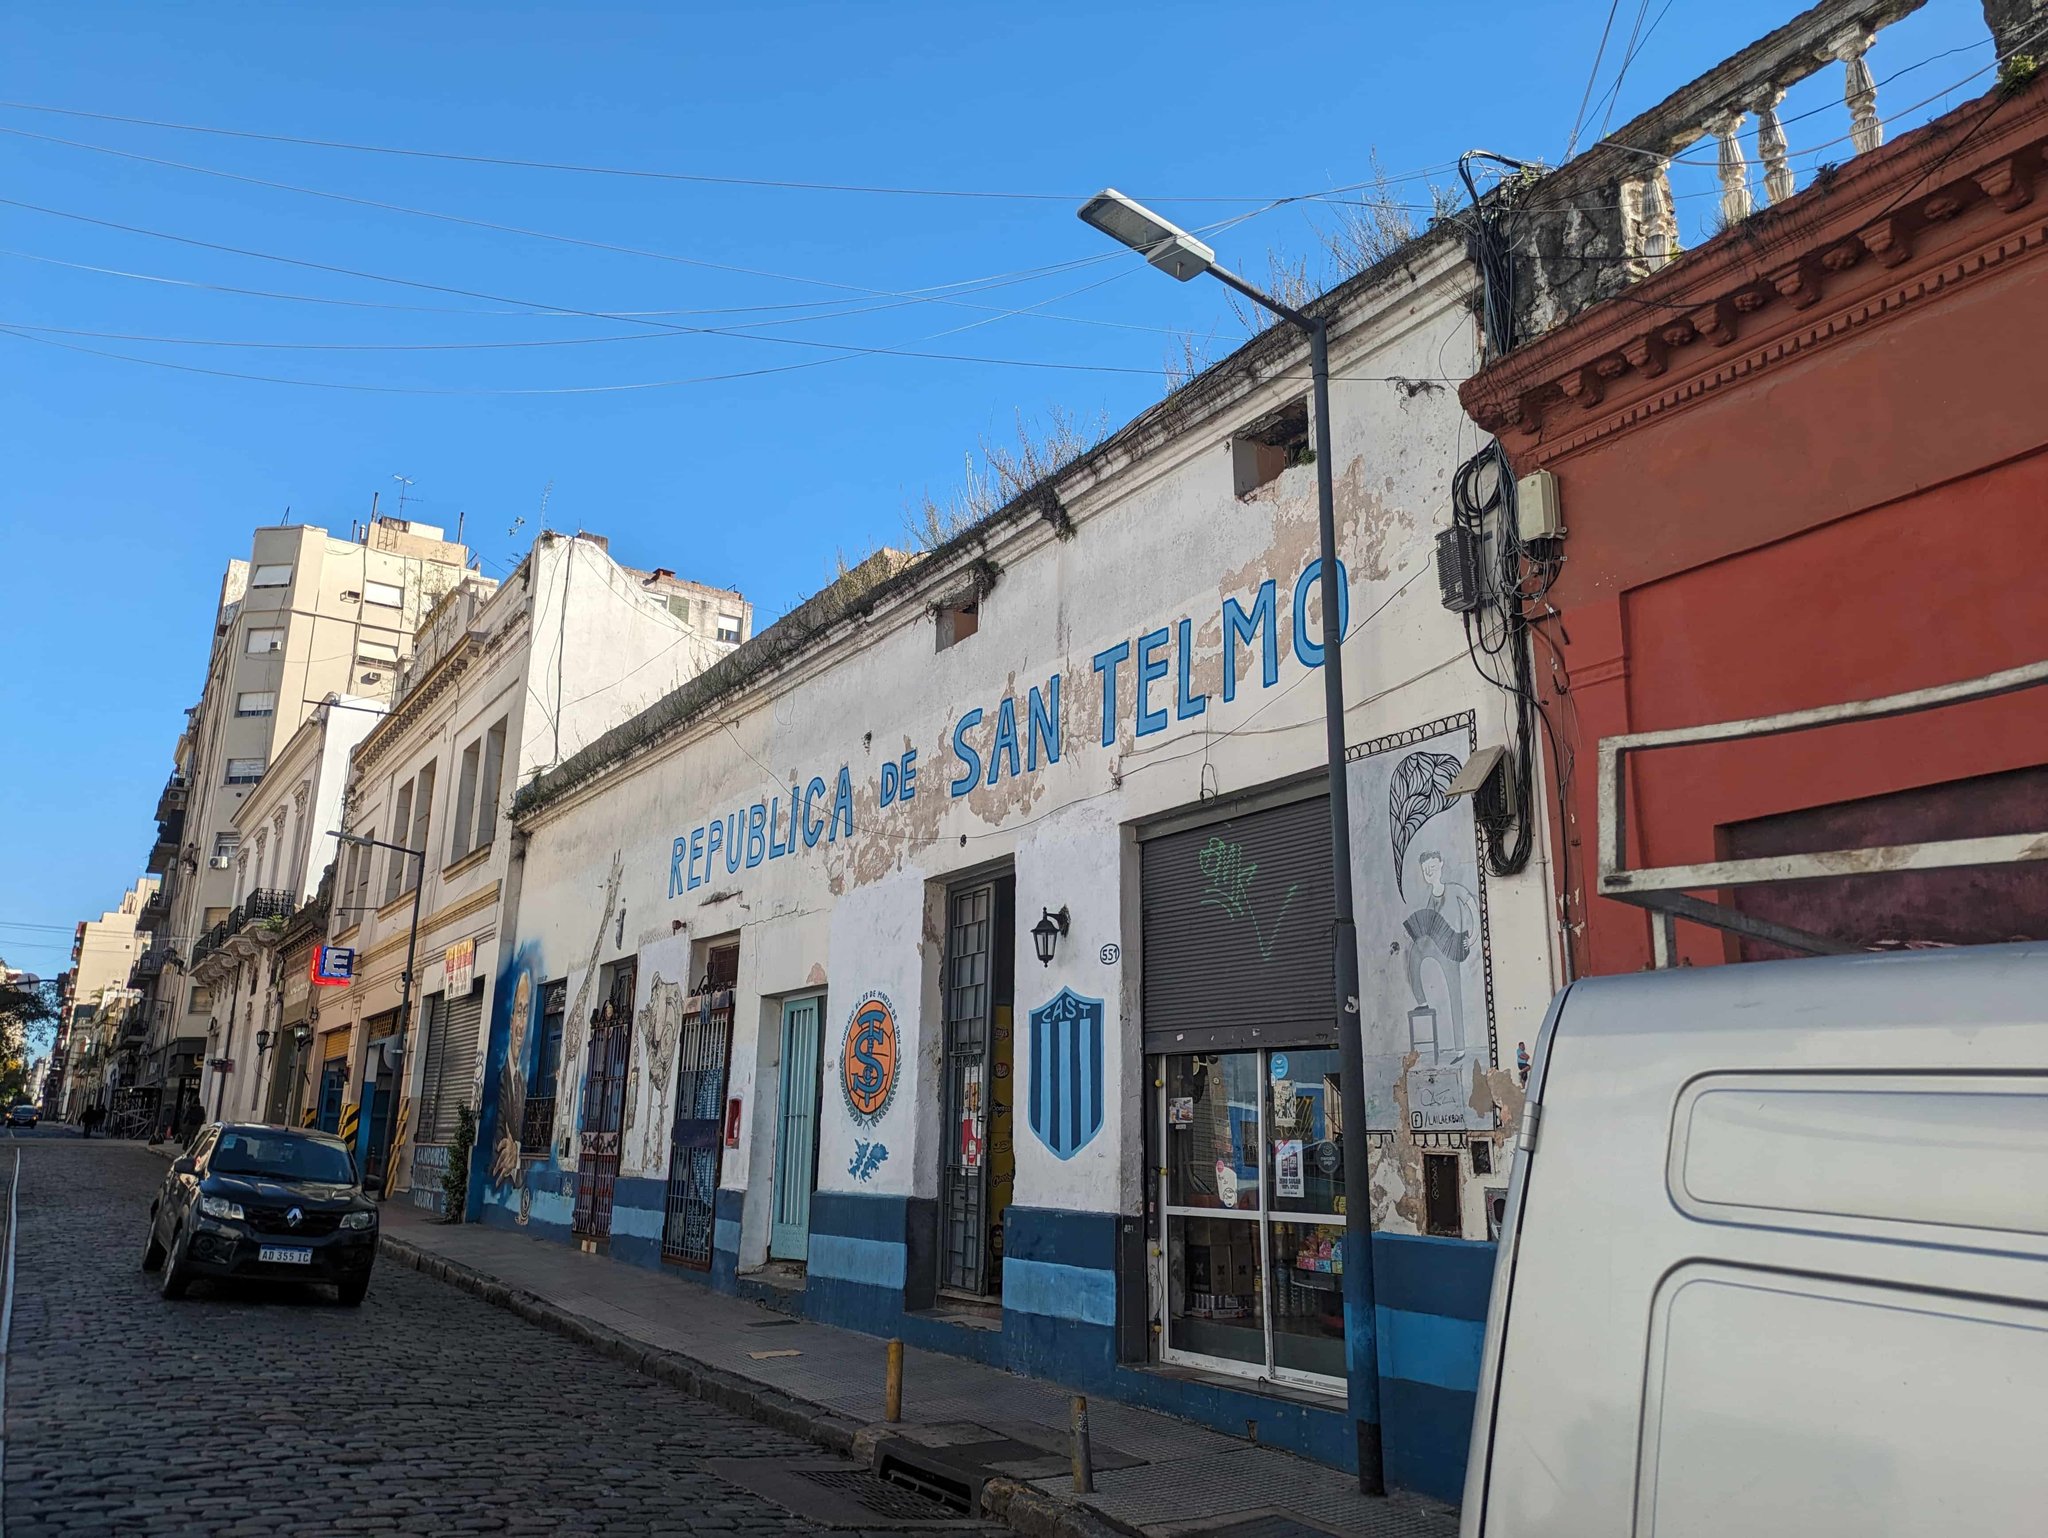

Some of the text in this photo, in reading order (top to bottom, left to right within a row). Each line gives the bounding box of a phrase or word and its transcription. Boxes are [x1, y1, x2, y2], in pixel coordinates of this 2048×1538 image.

[668, 557, 1348, 899] REPUBLICA DE SAN TELMO
[324, 949, 350, 975] E
[1102, 947, 1118, 961] 551
[1041, 996, 1091, 1023] CAST
[262, 1251, 274, 1260] AD
[277, 1252, 294, 1261] 355
